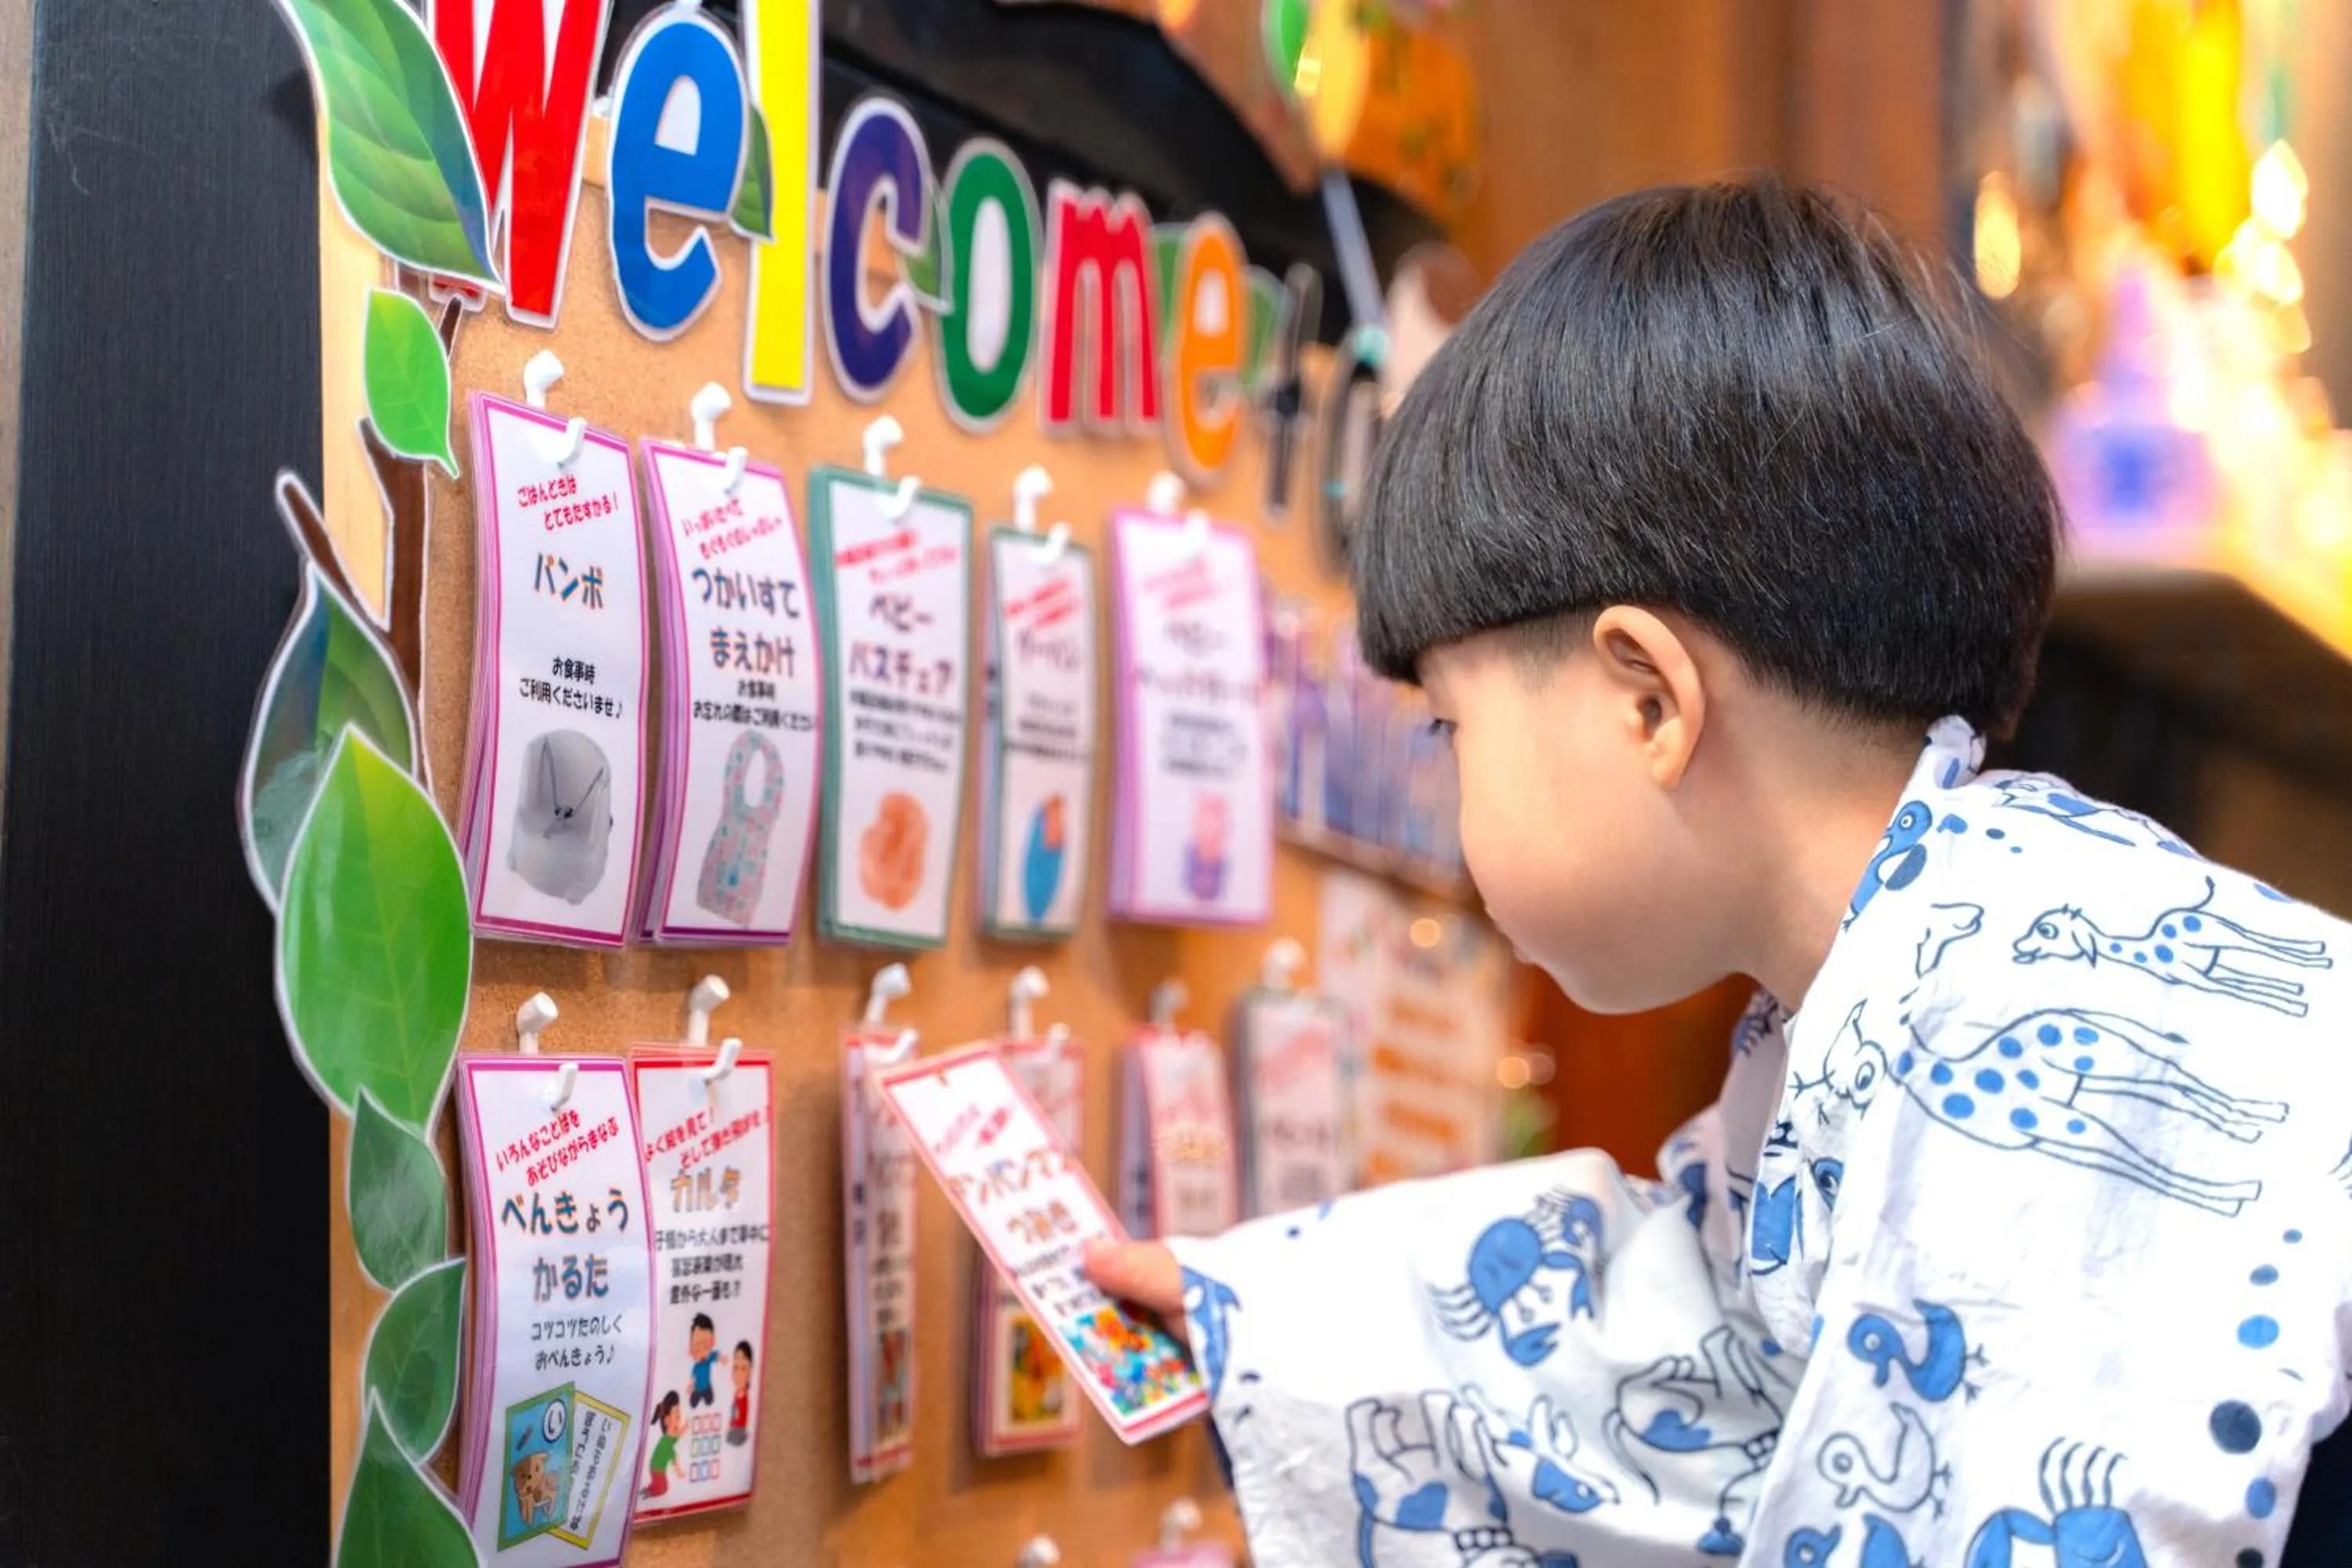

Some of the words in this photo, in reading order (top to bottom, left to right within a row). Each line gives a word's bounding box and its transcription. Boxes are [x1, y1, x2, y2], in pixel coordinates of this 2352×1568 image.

[428, 0, 1247, 470] Welcome
[517, 474, 577, 507] ごはんどきは
[691, 567, 800, 619] つかいすて
[552, 656, 595, 685] お食事時
[710, 625, 795, 679] まえかけ
[496, 1109, 580, 1172] いろんなことばを
[526, 1116, 619, 1187] あそびながらまなぶ
[501, 1188, 629, 1236] べんきょう
[670, 1167, 742, 1213] カルタ
[532, 1254, 608, 1302] かるた
[532, 1313, 622, 1341] コツコツたのしく
